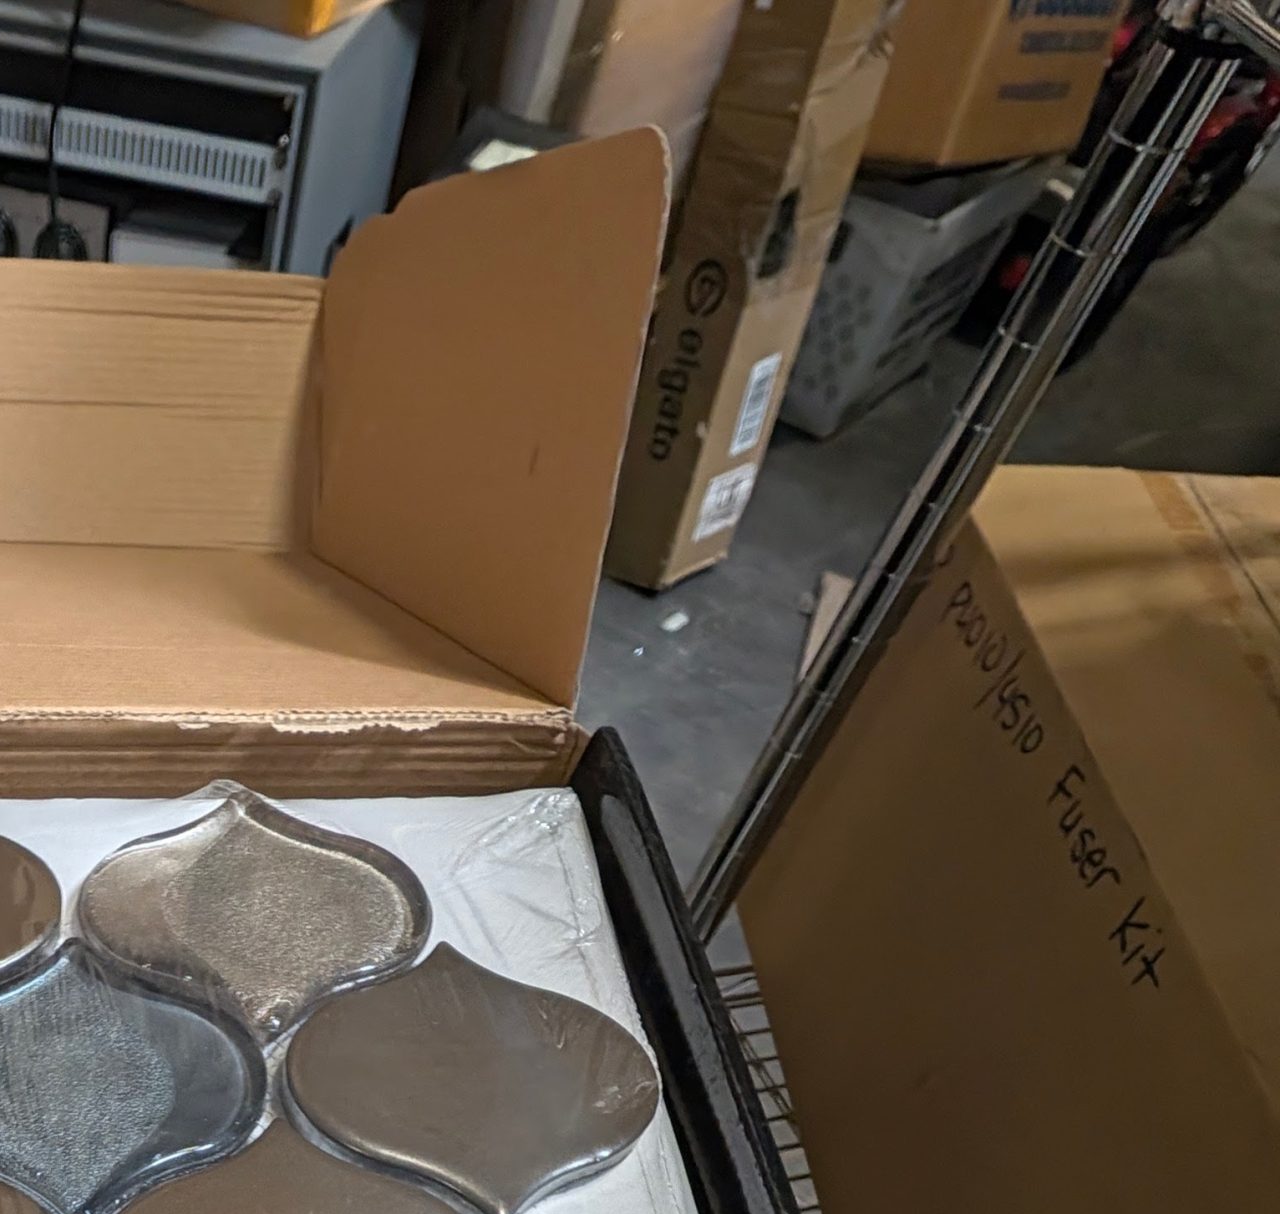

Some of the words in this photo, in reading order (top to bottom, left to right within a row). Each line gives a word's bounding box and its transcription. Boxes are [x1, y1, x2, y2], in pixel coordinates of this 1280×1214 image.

[650, 328, 703, 461] elgato
[1047, 764, 1122, 889] Fuser
[1107, 896, 1166, 989] Kit
